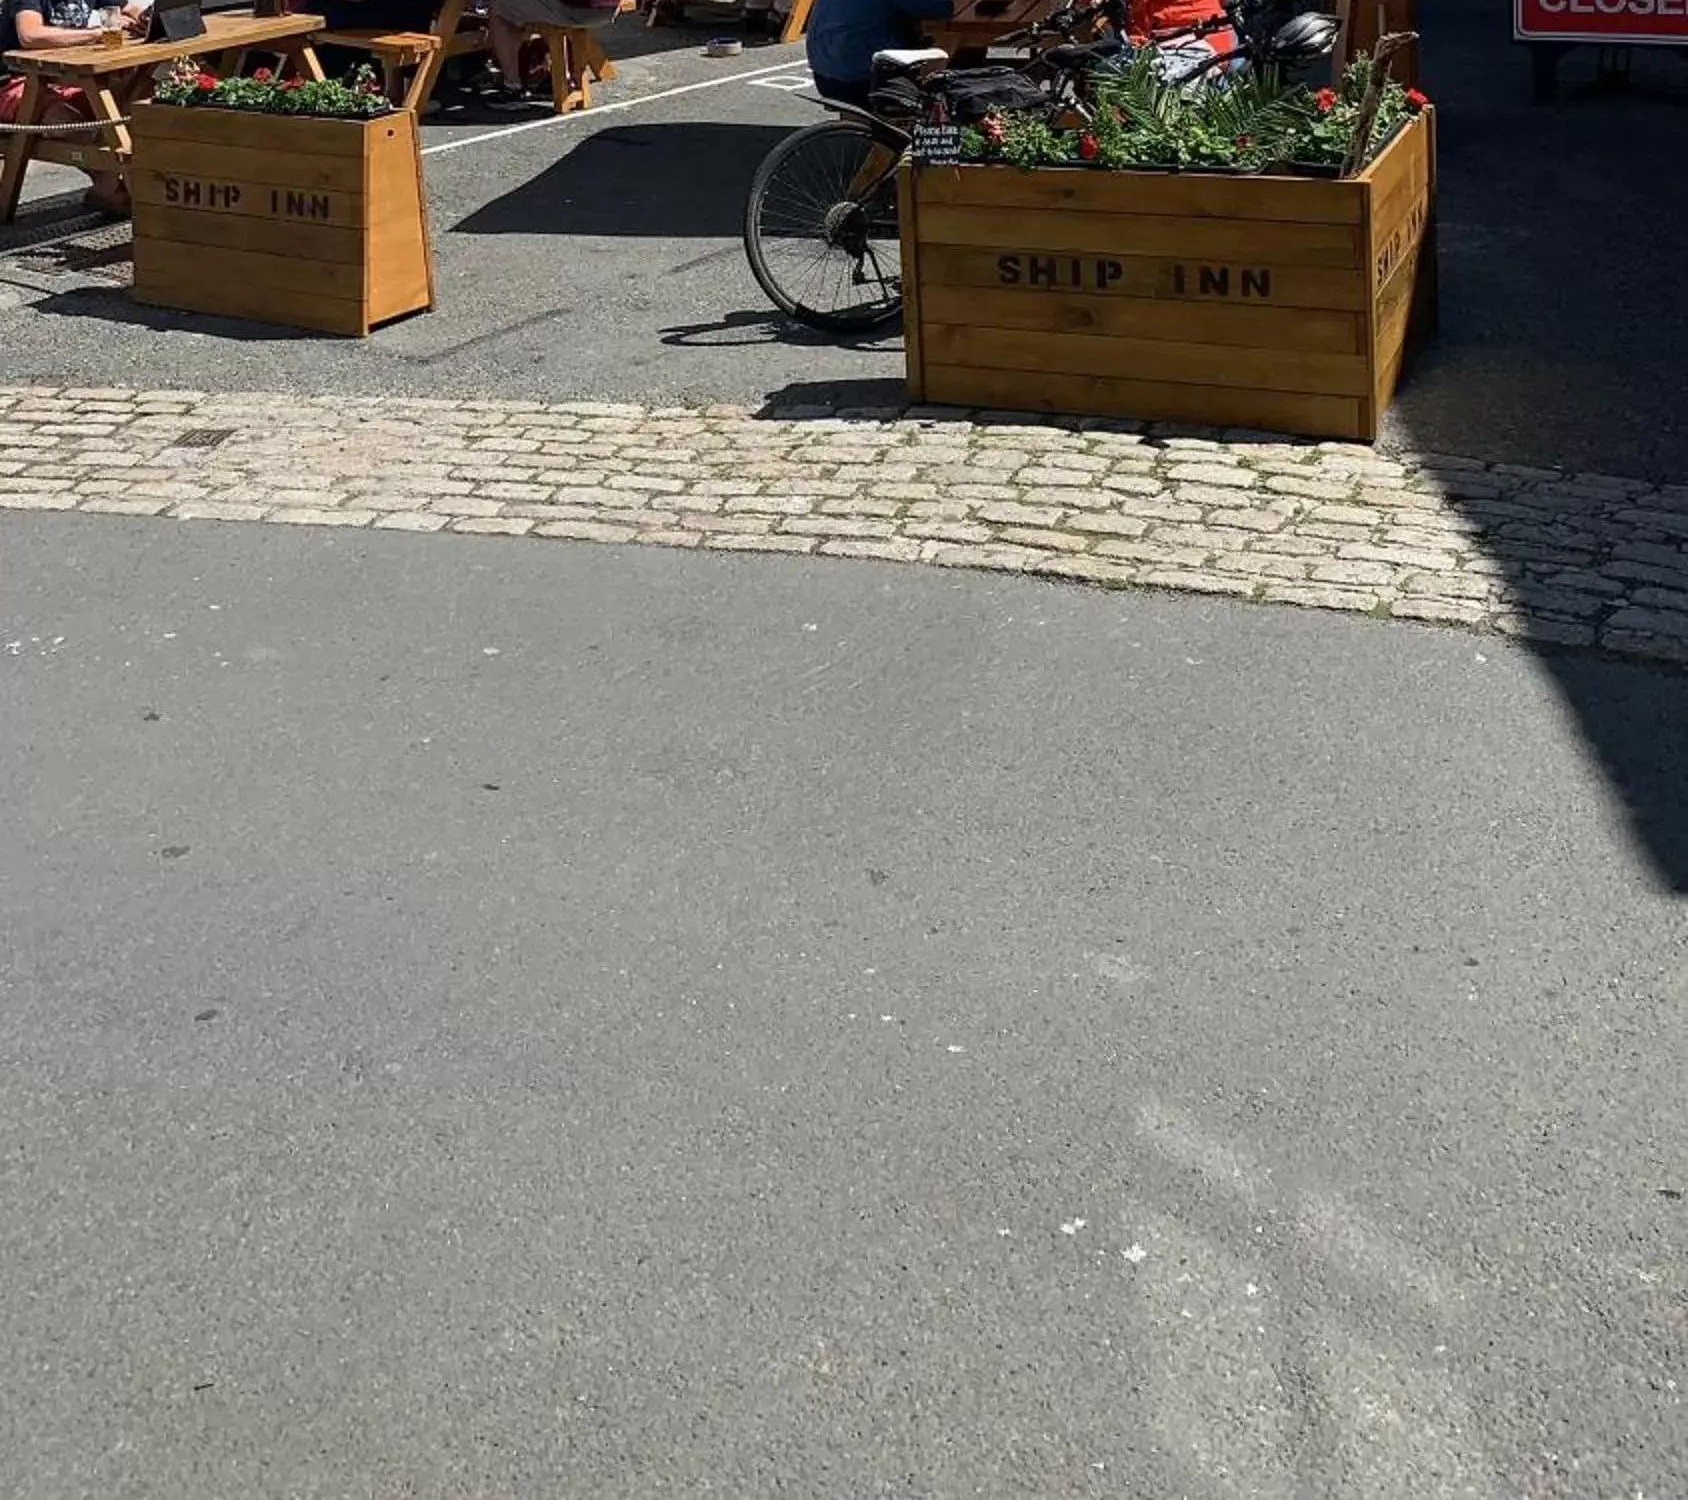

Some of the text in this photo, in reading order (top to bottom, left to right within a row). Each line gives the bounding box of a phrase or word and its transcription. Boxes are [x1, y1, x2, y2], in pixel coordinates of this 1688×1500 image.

[165, 178, 329, 219] SHIP INN
[997, 255, 1271, 298] SHIP INN
